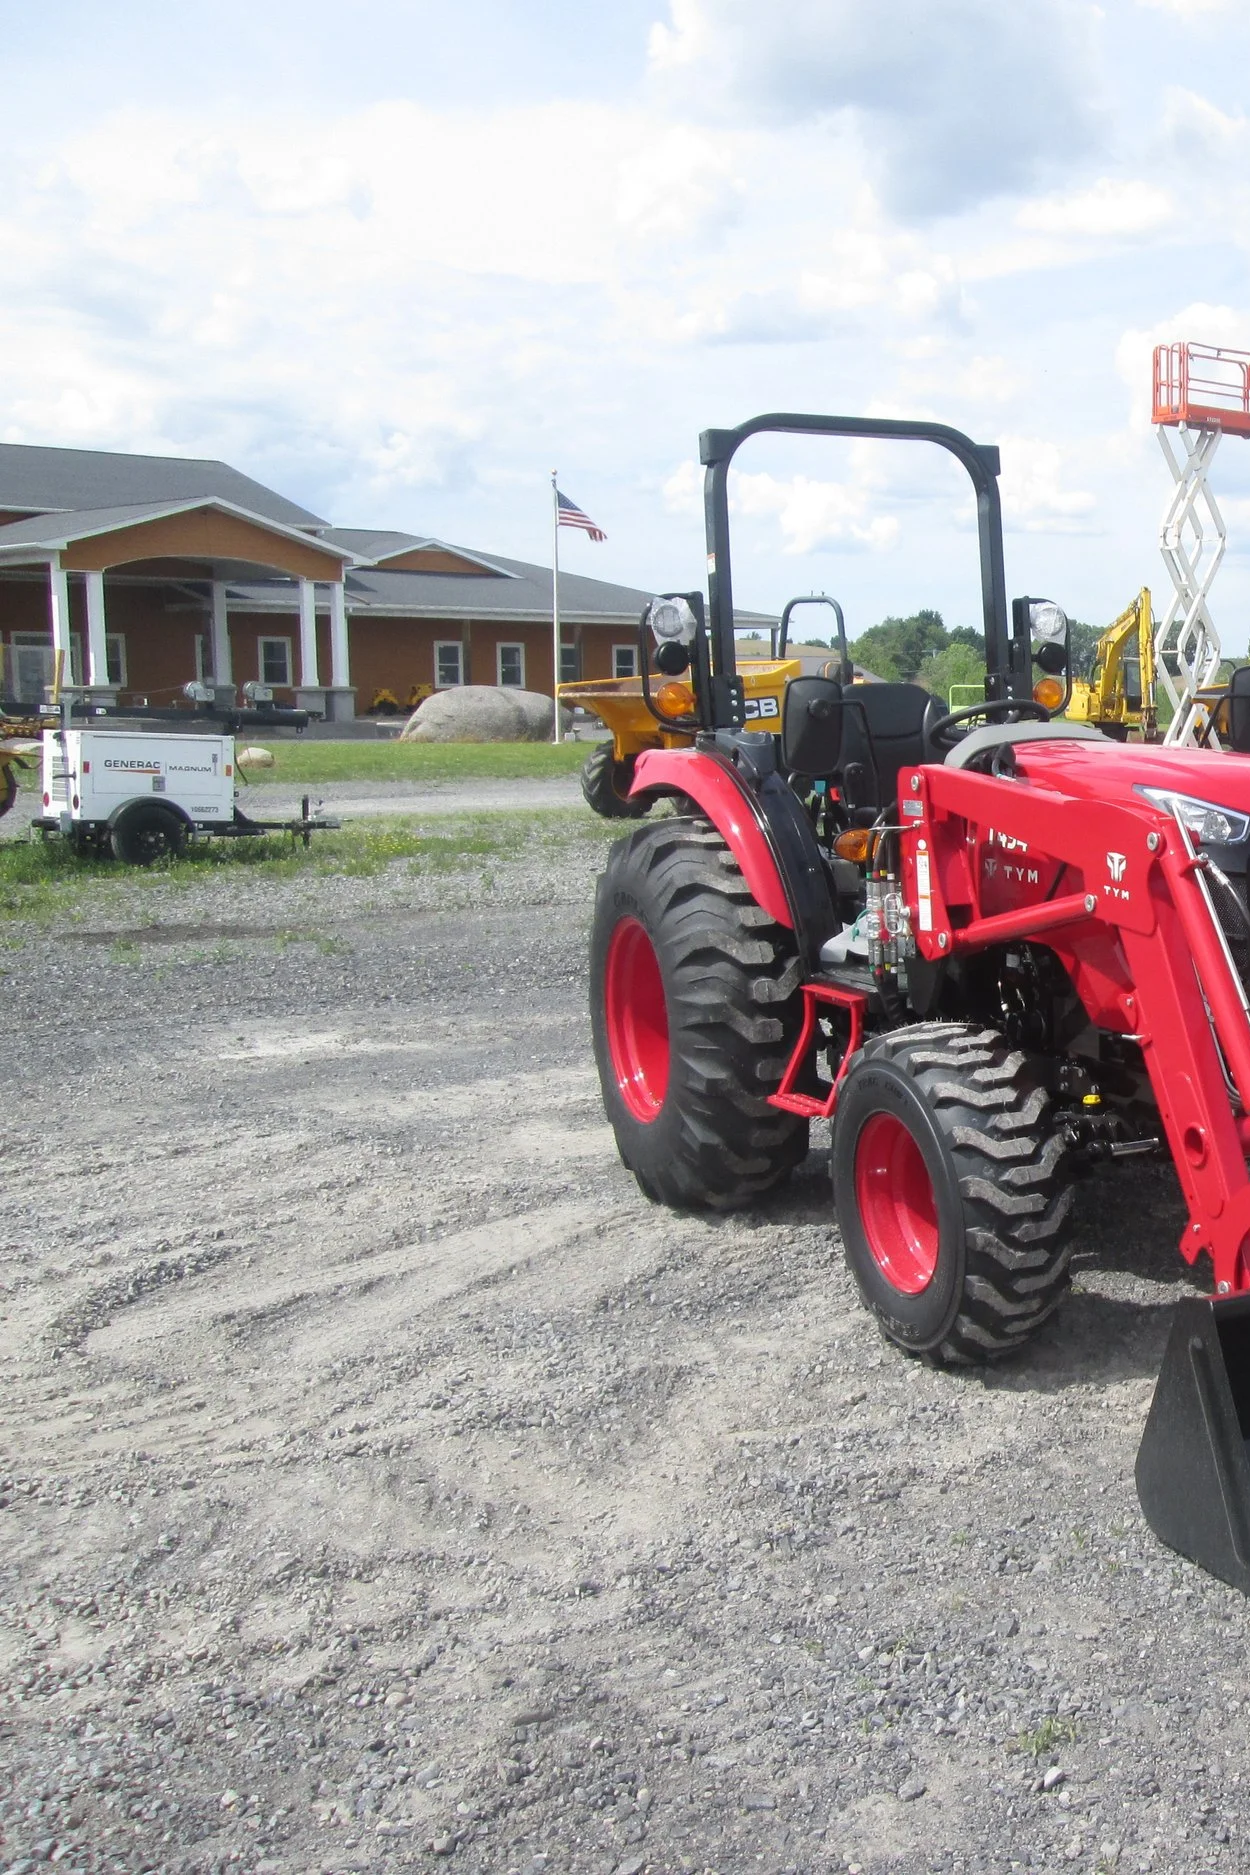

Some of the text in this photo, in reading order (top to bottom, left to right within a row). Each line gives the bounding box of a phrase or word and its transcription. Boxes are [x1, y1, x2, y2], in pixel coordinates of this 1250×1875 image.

[744, 698, 778, 719] CB
[104, 759, 160, 769] GENERAC
[1004, 865, 1038, 884] TYM
[1103, 885, 1130, 900] TYM
